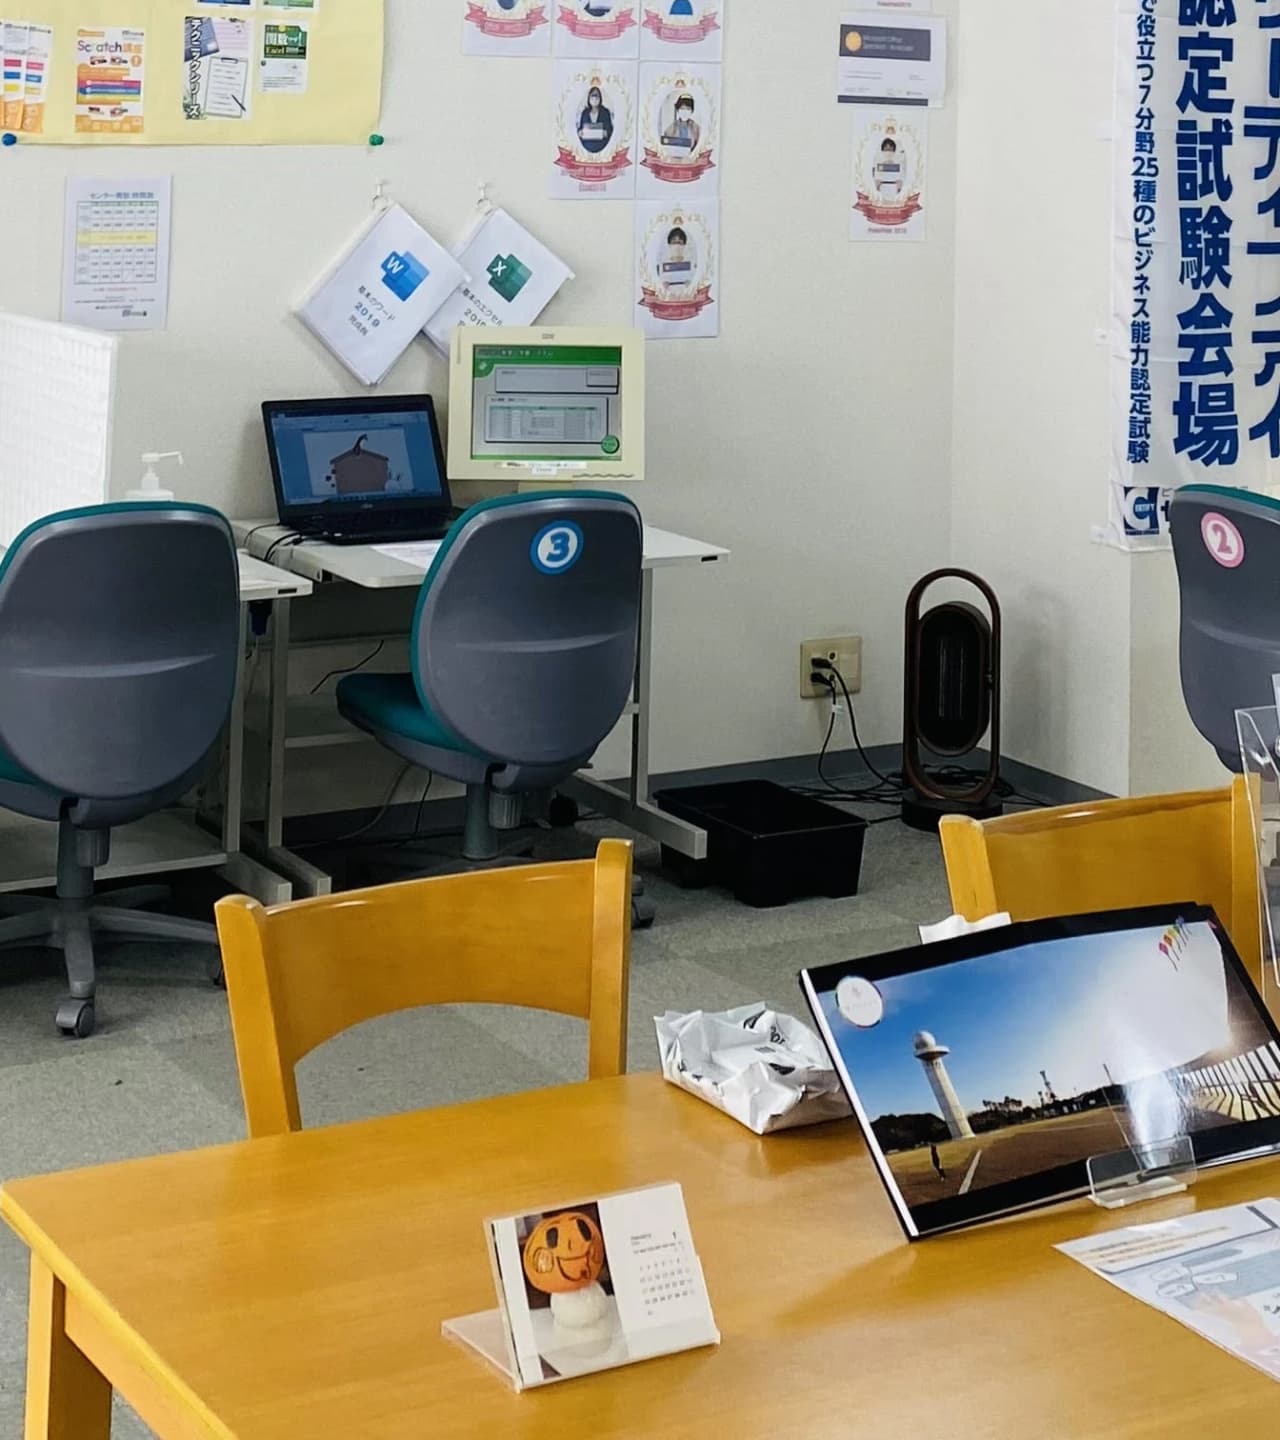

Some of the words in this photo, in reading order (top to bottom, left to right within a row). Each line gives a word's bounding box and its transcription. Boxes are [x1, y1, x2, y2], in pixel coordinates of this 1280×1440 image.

[387, 259, 403, 274] W
[492, 261, 507, 276] X
[354, 301, 380, 328] 2019
[358, 284, 396, 322] 基本のワード
[545, 530, 569, 562] 3
[1211, 523, 1233, 554] 2
